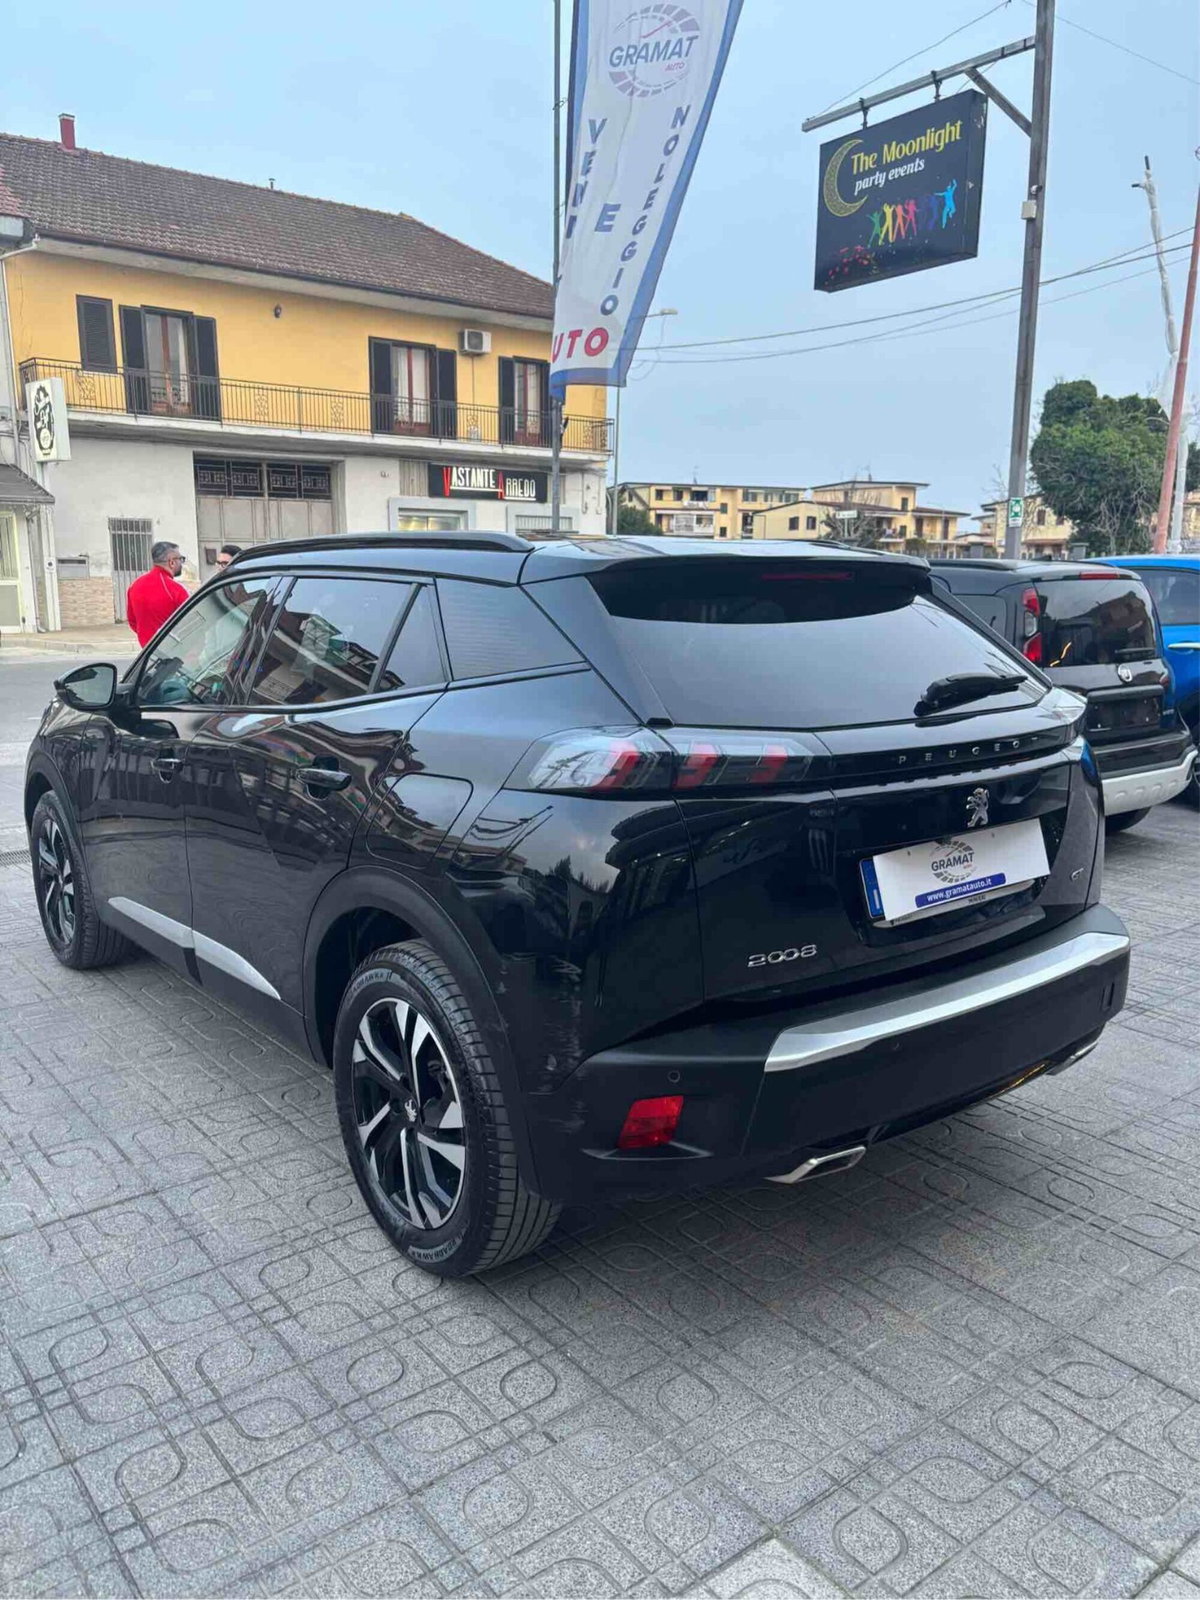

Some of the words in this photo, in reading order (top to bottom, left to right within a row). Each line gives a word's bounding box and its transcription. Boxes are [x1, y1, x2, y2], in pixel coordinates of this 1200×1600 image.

[609, 35, 699, 68] GRAMAT
[851, 152, 878, 176] The
[882, 119, 963, 165] Moonlight
[854, 171, 887, 196] party
[888, 158, 926, 181] events
[594, 203, 622, 233] E
[600, 104, 691, 316] NOLEGGIO
[443, 466, 496, 497] VASTANTE
[497, 471, 536, 499] ARREDO
[931, 852, 975, 872] GRAMAT
[926, 878, 993, 903] www.gramatauto.it
[747, 943, 818, 968] 2008
